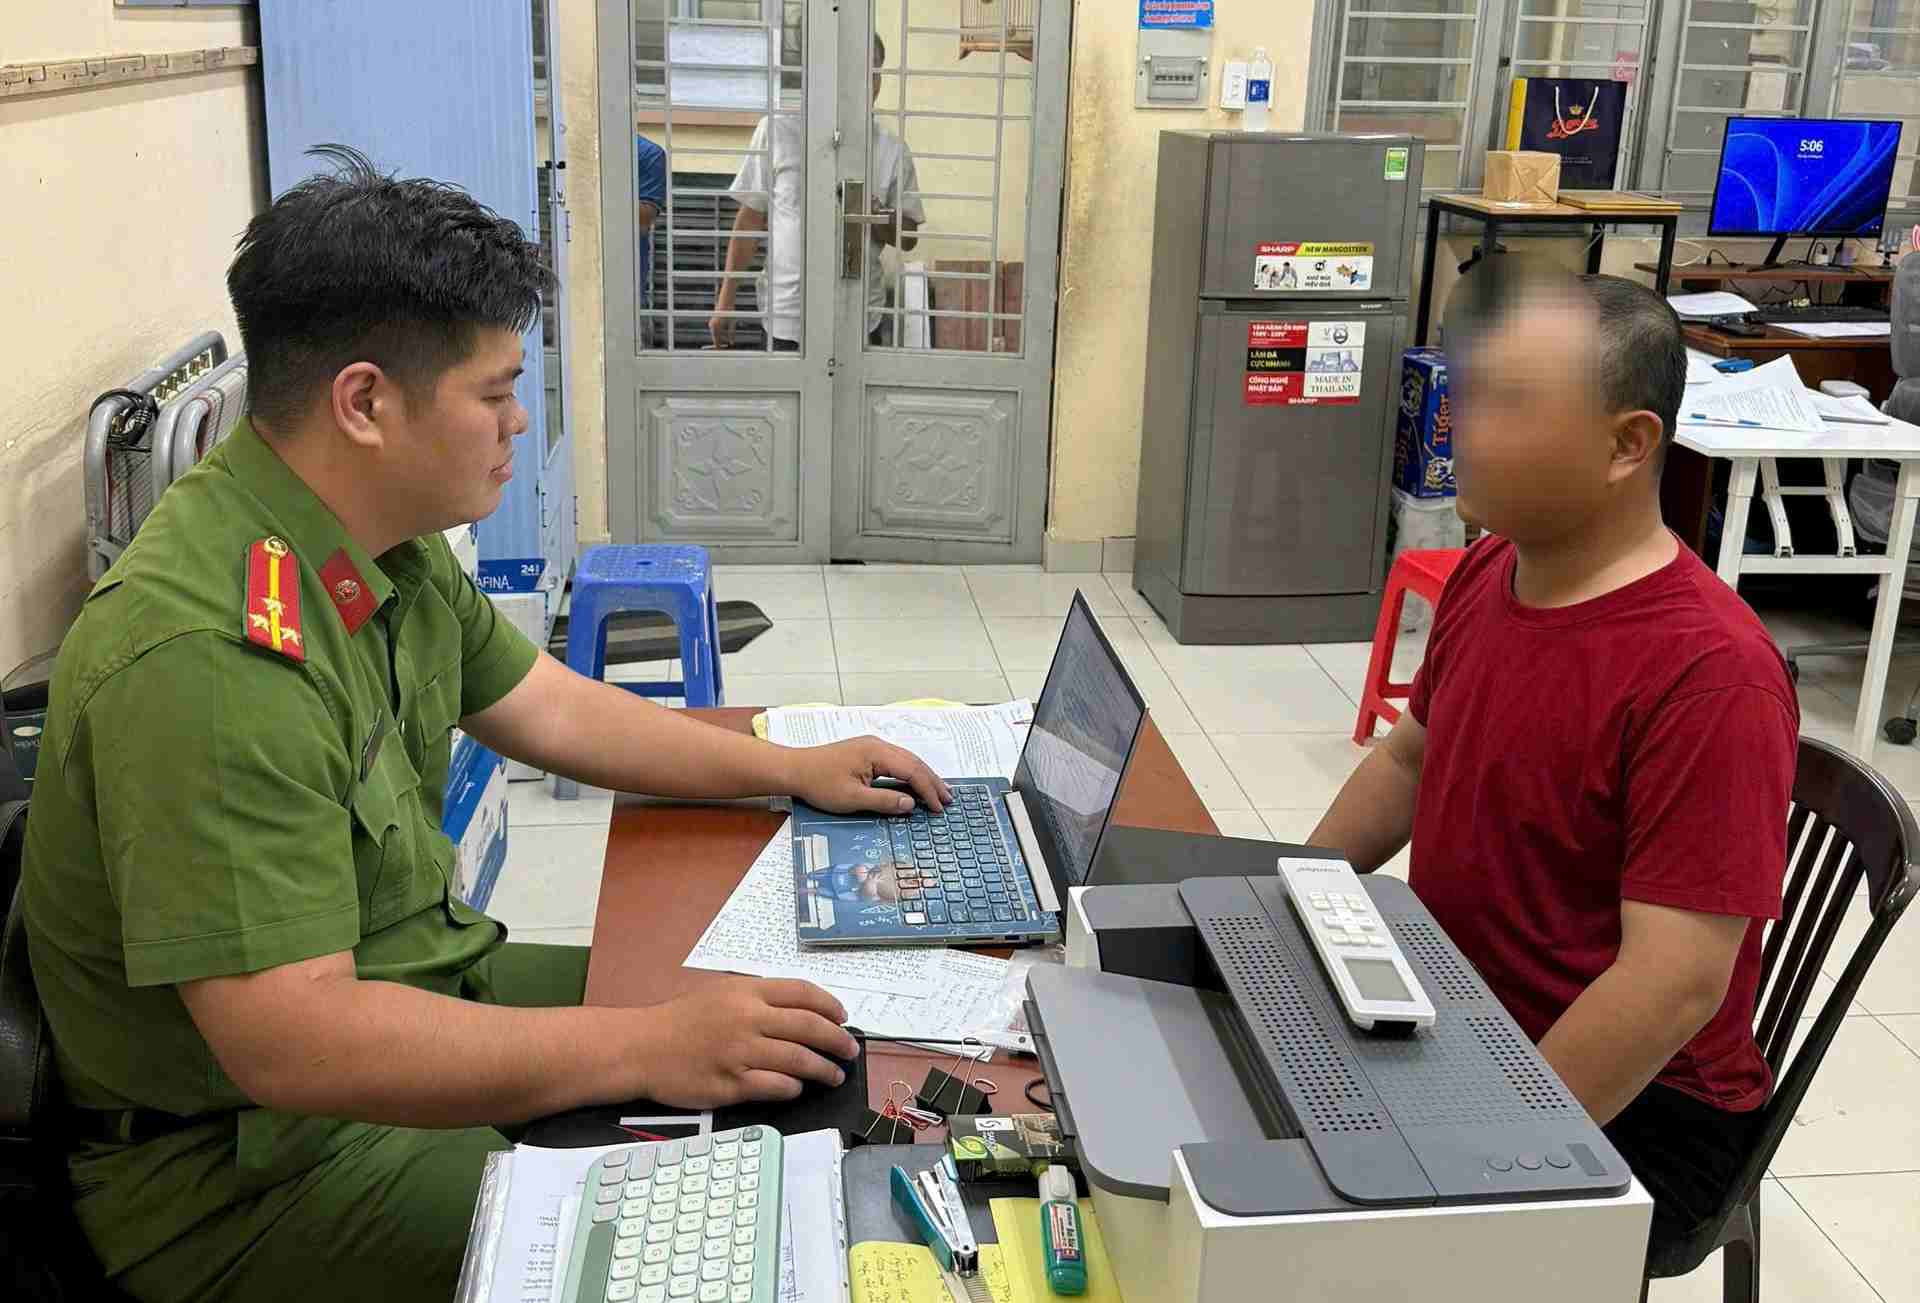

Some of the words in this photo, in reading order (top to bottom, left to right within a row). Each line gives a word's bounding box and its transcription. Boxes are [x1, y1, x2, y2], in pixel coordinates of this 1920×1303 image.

[1800, 140, 1823, 152] 5:06
[1260, 245, 1296, 253] SHARP
[1314, 375, 1340, 383] MADE
[1342, 375, 1352, 383] IN
[1311, 383, 1354, 393] THAILAND
